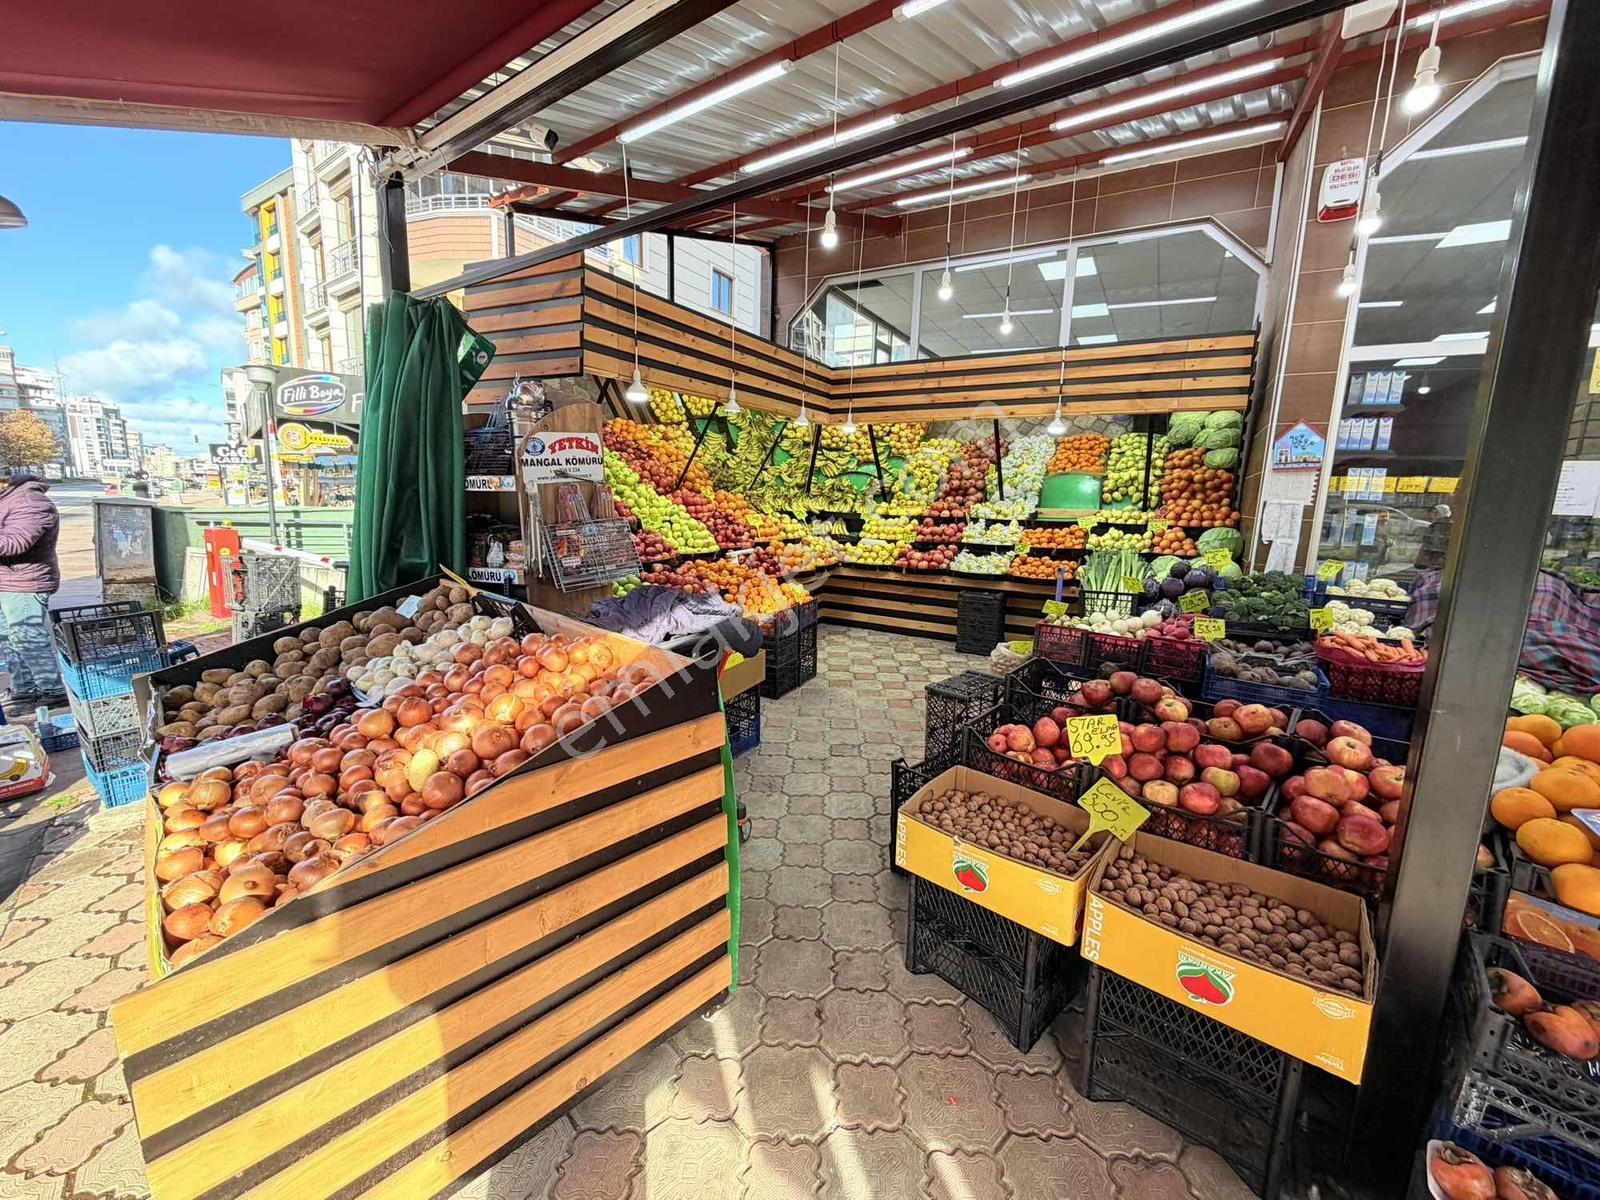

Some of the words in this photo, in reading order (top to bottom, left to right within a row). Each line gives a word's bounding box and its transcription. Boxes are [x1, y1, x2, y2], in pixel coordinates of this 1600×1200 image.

[283, 387, 307, 403] Filli
[309, 385, 343, 402] Boya
[547, 436, 599, 455] YETKİN
[521, 457, 562, 467] MANGAL
[565, 455, 604, 467] KÖMÜRÜ
[468, 569, 502, 582] ÖMÜRÜ
[1069, 717, 1105, 734] STAR
[1091, 723, 1118, 735] ELMA
[1072, 732, 1117, 754] 69.95
[895, 815, 908, 867] APPLES
[1085, 895, 1105, 961] APPLES
